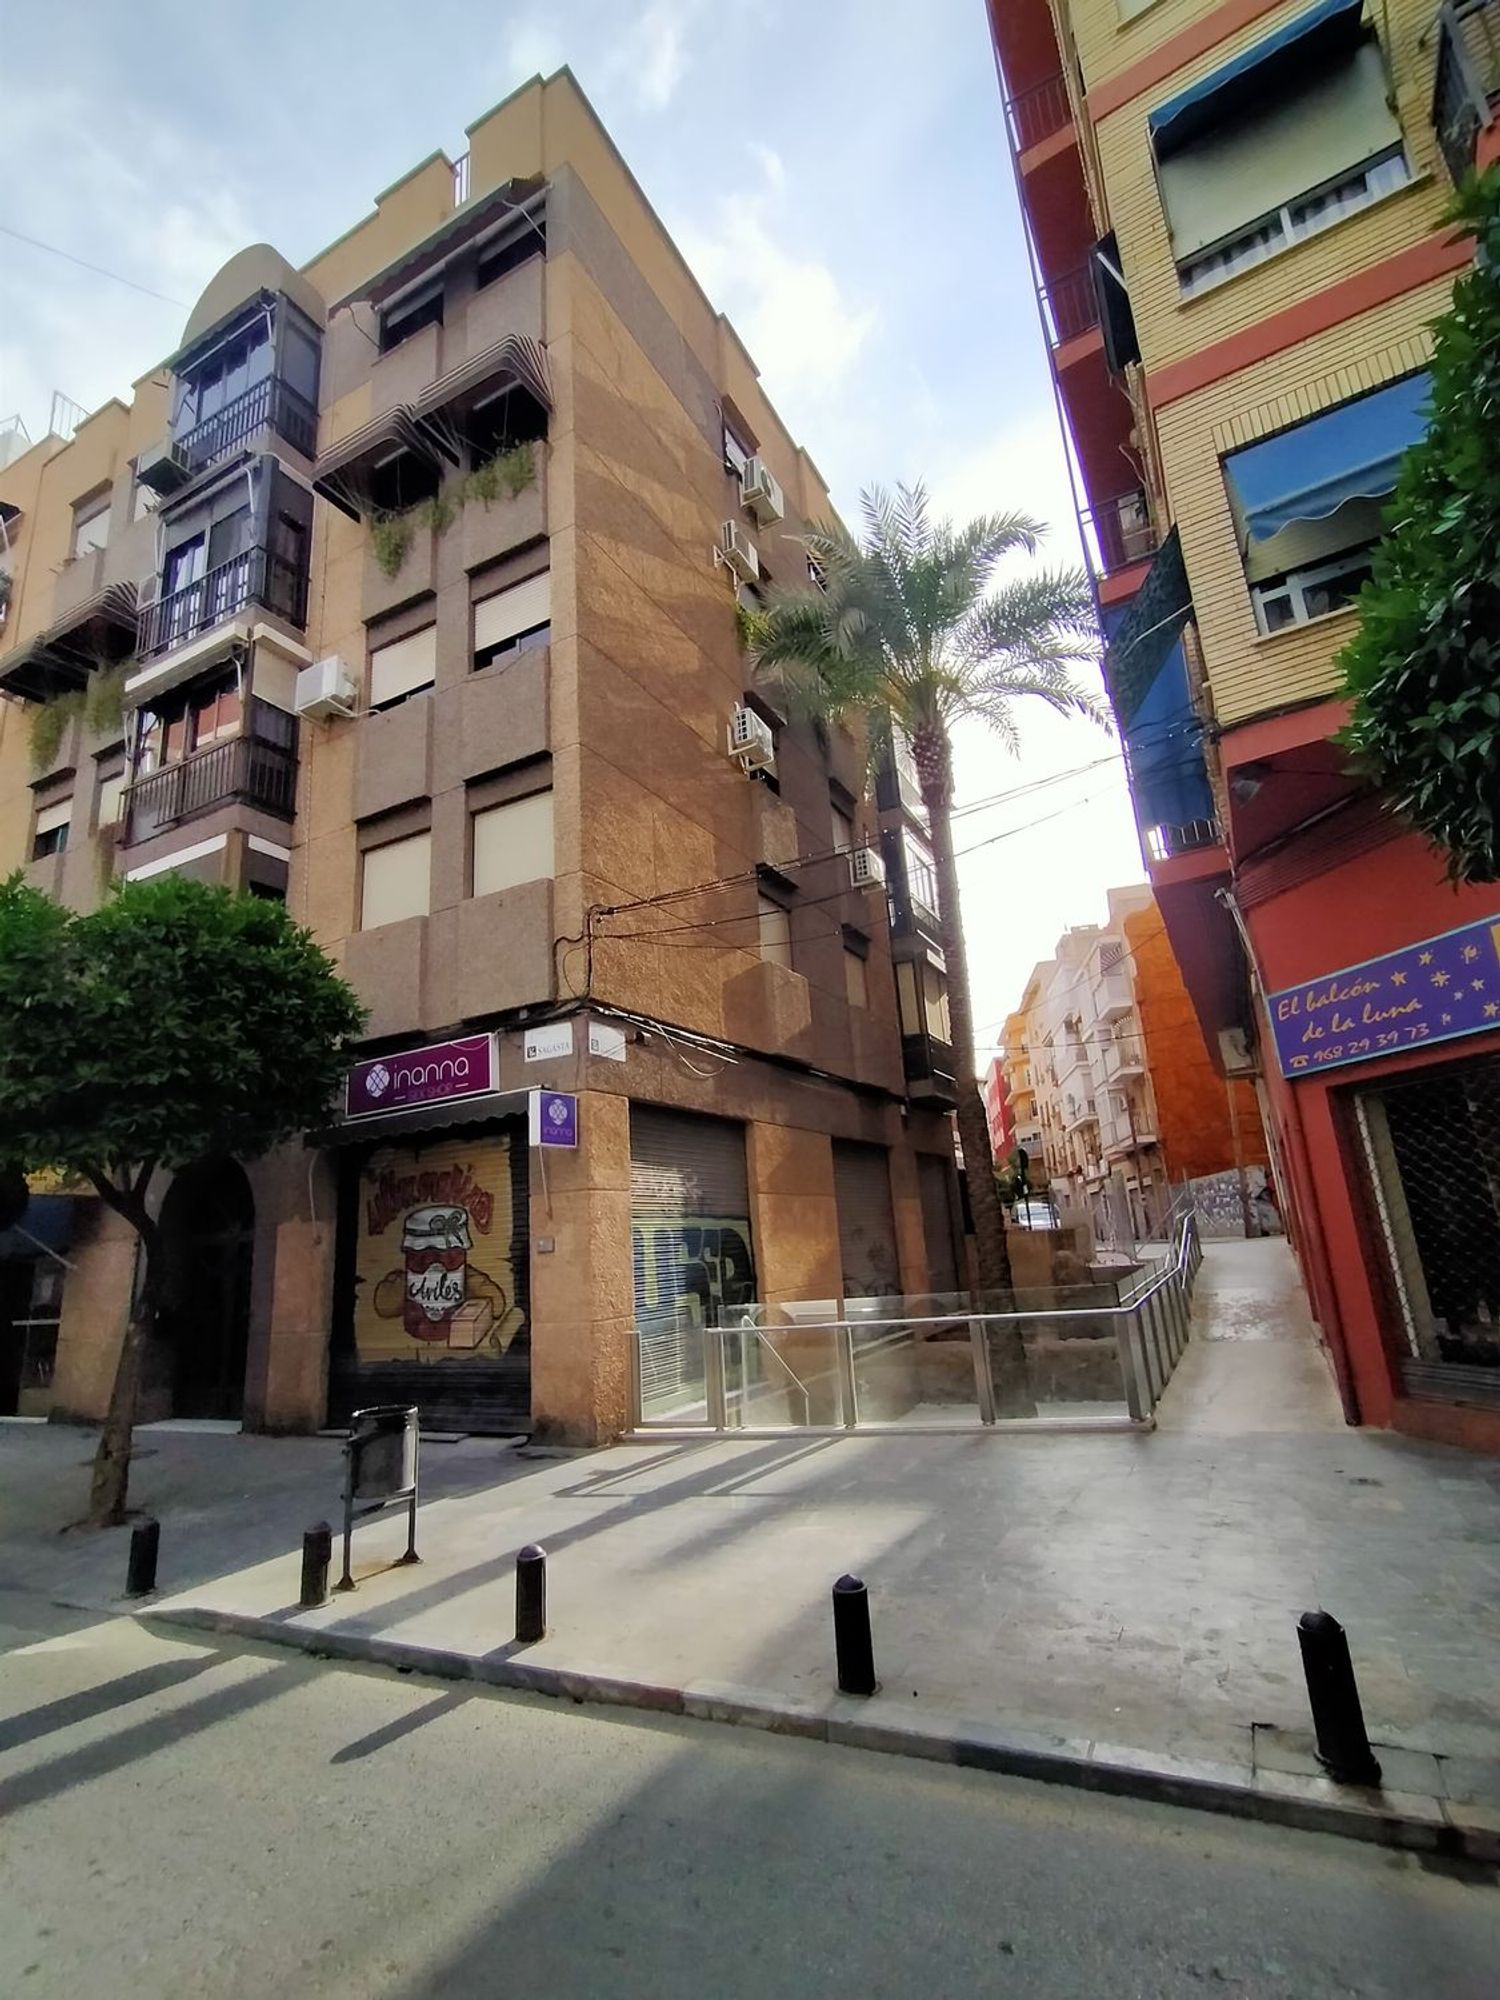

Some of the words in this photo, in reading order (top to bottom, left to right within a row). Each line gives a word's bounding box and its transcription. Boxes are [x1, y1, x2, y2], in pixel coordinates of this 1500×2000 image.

[1278, 996, 1300, 1021] El
[1306, 978, 1380, 1012] balcón
[1302, 1021, 1326, 1043] de
[1331, 1013, 1356, 1032] la
[1362, 998, 1423, 1023] luna
[1314, 1046, 1343, 1062] 968
[1348, 1038, 1370, 1054] 29
[1376, 1031, 1398, 1047] 39
[1404, 1023, 1430, 1039] 73
[393, 1057, 469, 1089] inanna
